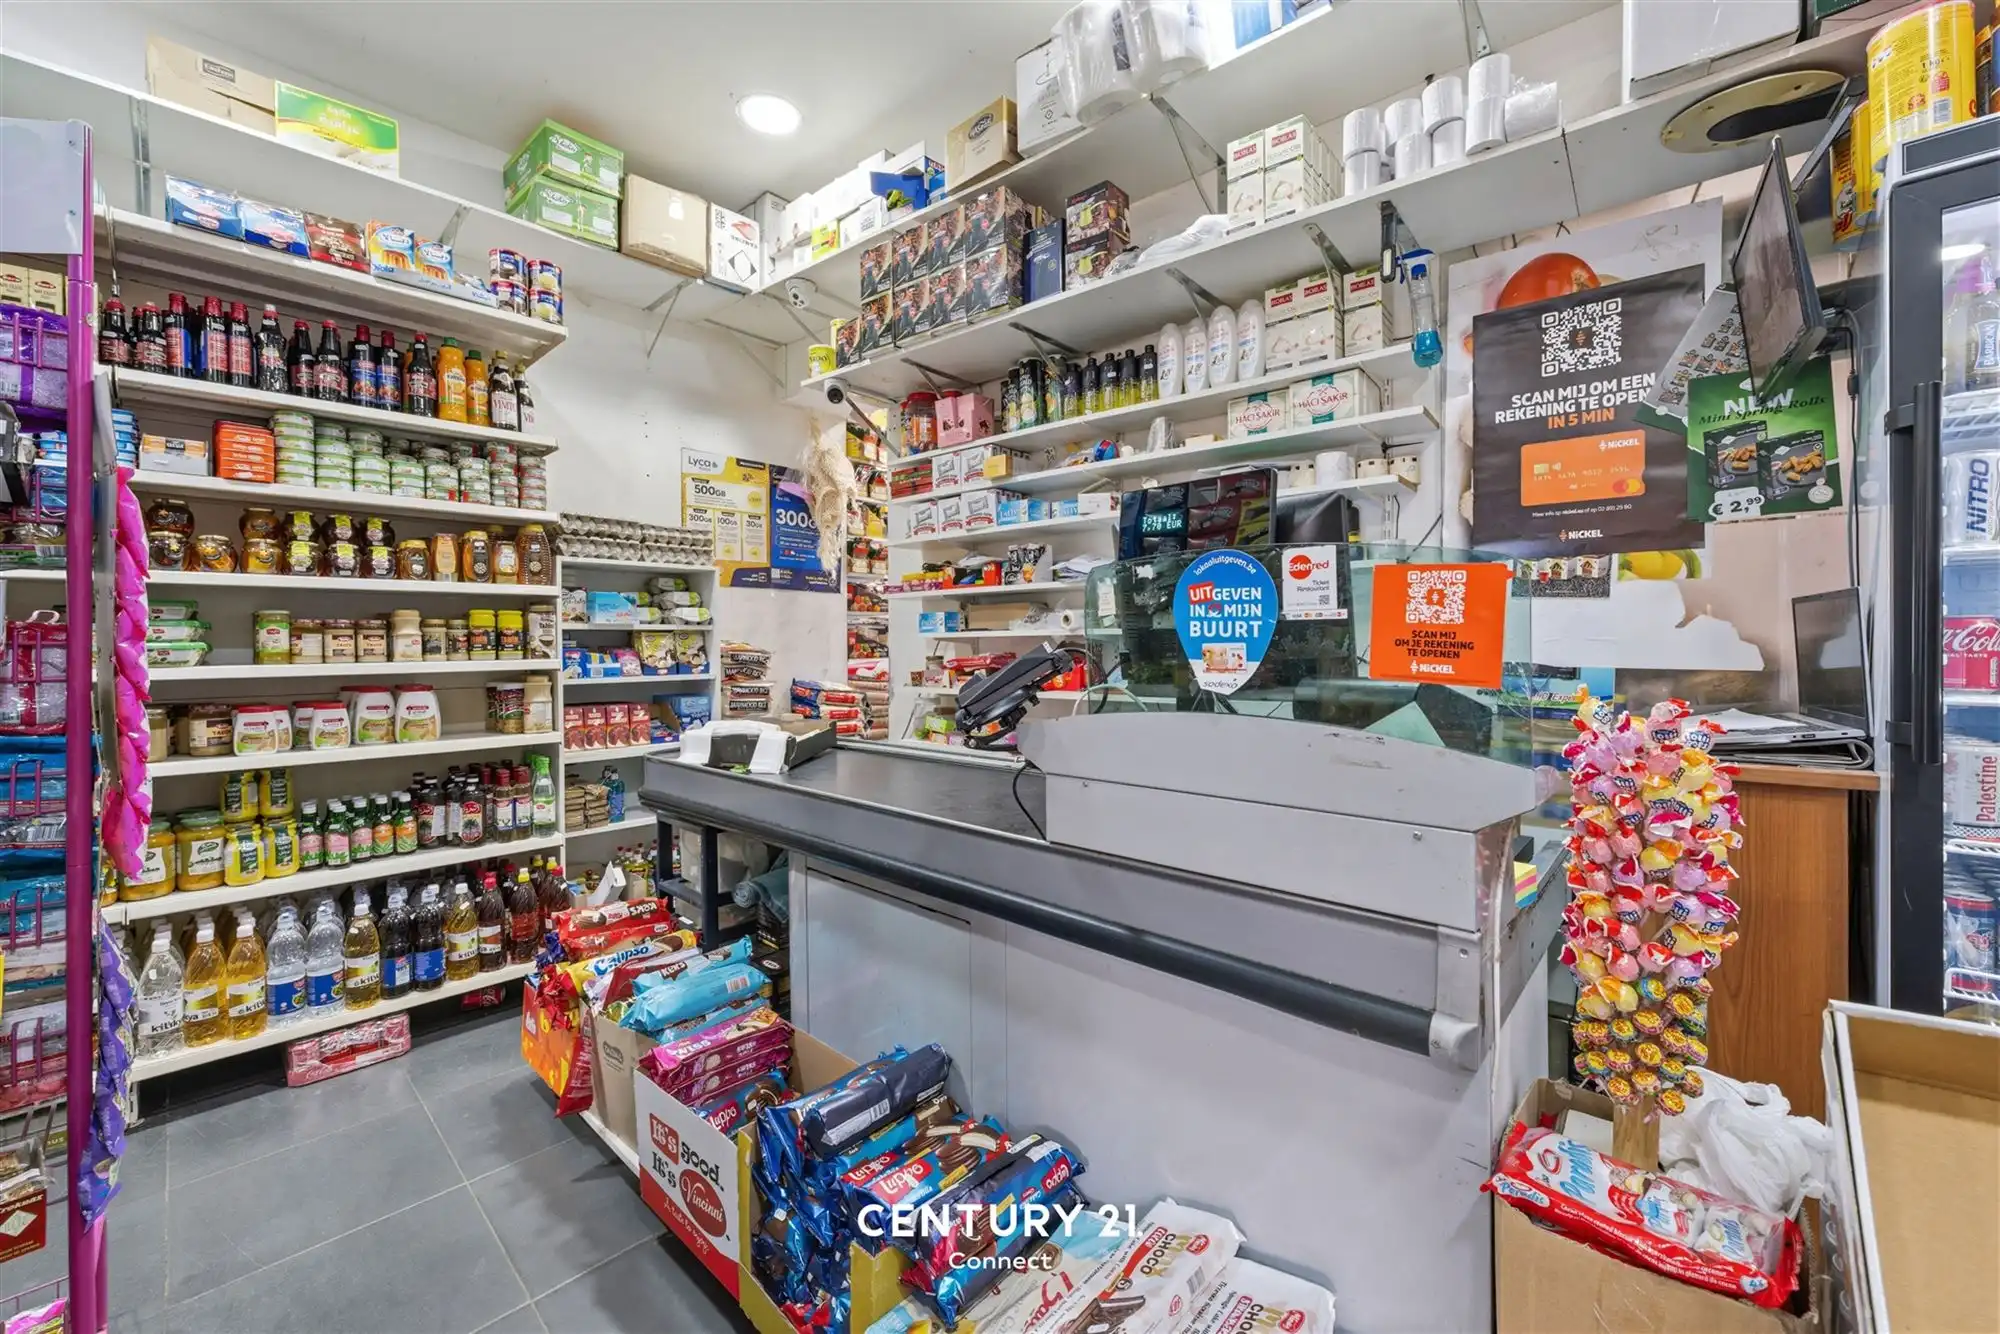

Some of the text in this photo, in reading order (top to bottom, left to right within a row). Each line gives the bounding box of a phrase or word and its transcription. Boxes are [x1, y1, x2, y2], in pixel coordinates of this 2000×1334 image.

[1511, 372, 1657, 408] SCAN MIJ OM EEN
[1495, 388, 1650, 424] REKENING TE OPEN
[1699, 396, 1828, 425] Mini Spring Rolls
[1547, 407, 1616, 430] IN 5 MIN
[688, 455, 711, 468] Lyca
[694, 484, 726, 497] 500GB
[1966, 458, 1989, 533] NITRO
[1712, 496, 1762, 516] € 2,99
[775, 508, 817, 529] 300G
[1167, 519, 1183, 530] EUR
[1193, 555, 1257, 576] lokaaluitgeven.be
[1289, 560, 1330, 572] Edenred
[1189, 586, 1262, 602] UITGEVEN
[1190, 604, 1262, 618] IN MIJN
[1189, 620, 1263, 638] BUURT
[1411, 630, 1456, 640] SCAN MIJ
[1395, 638, 1475, 650] OM JE REKENING
[1407, 648, 1460, 659] TE OPENEN
[1203, 680, 1238, 689] sodexo
[1976, 755, 1997, 822] Palestine
[593, 944, 649, 976] Calipso
[710, 1105, 737, 1130] Luppo
[652, 1118, 677, 1154] It's
[652, 1150, 677, 1189] It's
[880, 1162, 924, 1195] Luppo
[1046, 1164, 1070, 1190] Luppo
[1140, 1233, 1176, 1275] CHOCO
[1236, 1303, 1264, 1334] CHO
